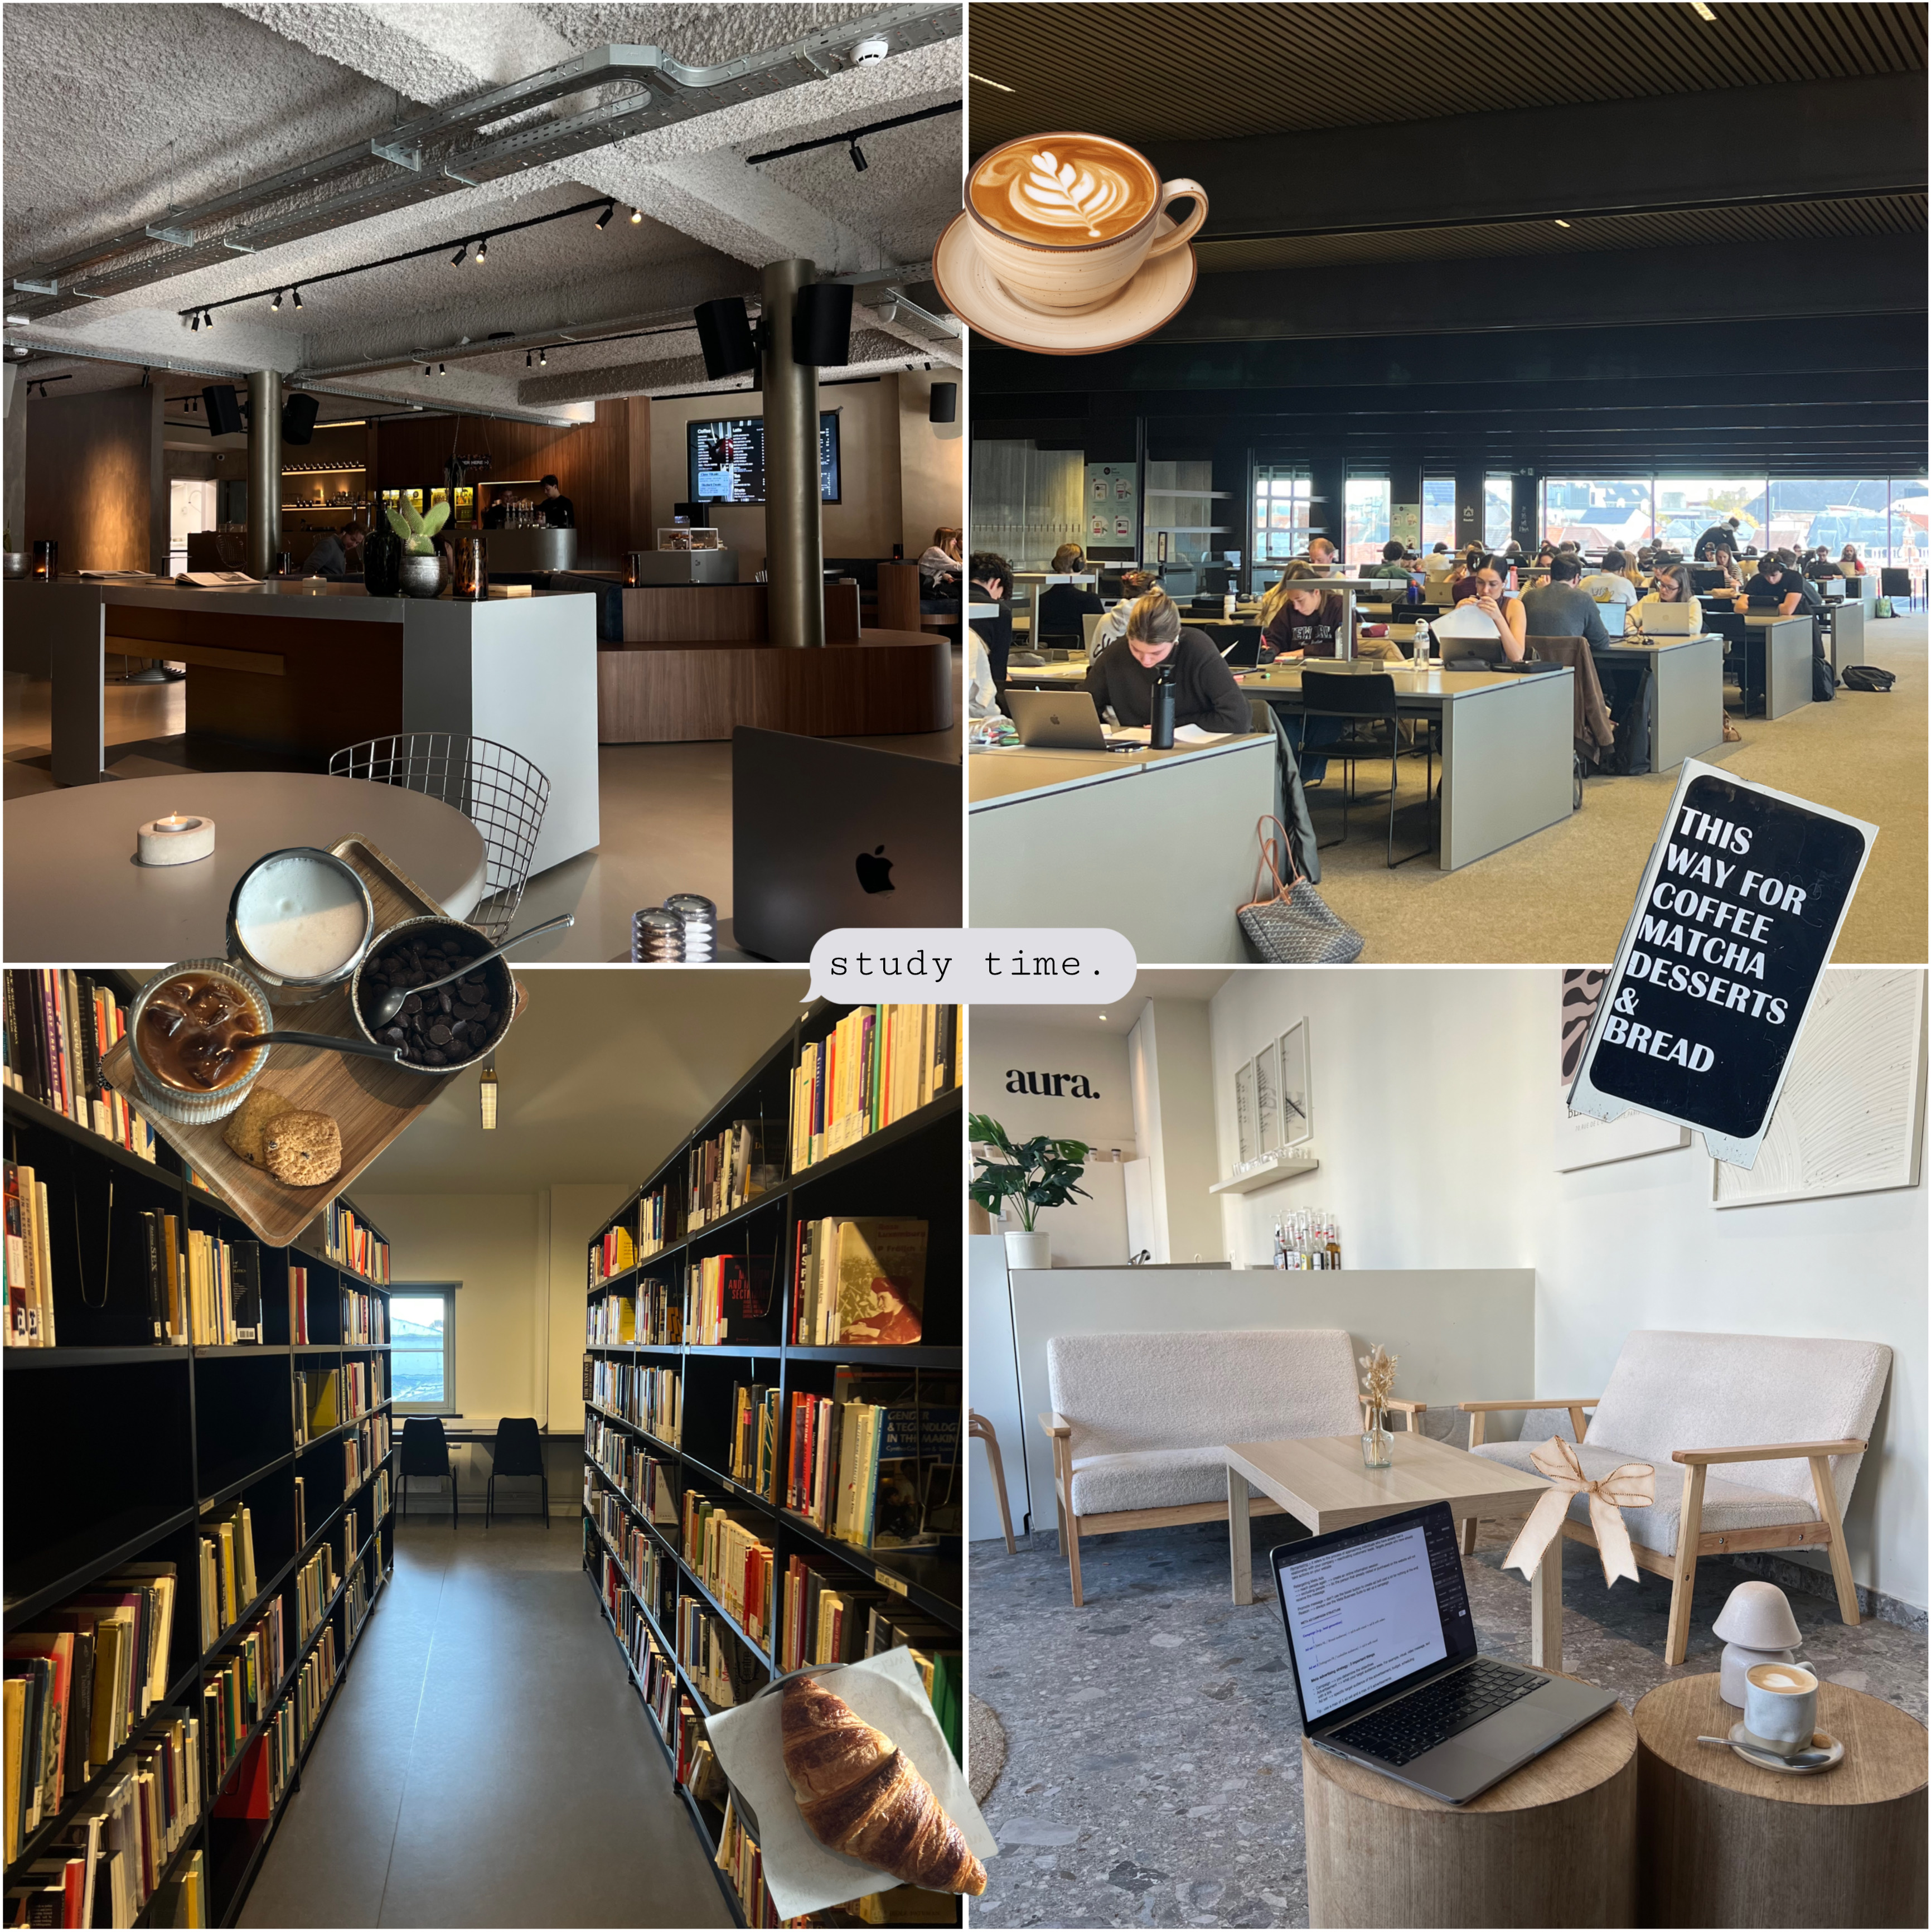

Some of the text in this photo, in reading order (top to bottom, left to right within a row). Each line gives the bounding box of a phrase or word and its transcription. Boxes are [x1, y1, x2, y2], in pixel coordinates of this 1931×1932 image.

[1681, 806, 1753, 855] THIS
[1667, 843, 1807, 915] WAY FOR
[1652, 882, 1774, 944] COFFEE
[1638, 914, 1766, 980] MATCHA
[1614, 987, 1640, 1017] &
[1625, 950, 1789, 1025] DESSERTS
[1603, 1015, 1715, 1073] BREAD
[73, 1049, 82, 1084] JUSTICE
[1005, 1069, 1101, 1099] aura.
[20, 1195, 26, 1209] ON
[728, 1279, 742, 1289] AND
[887, 1411, 930, 1421] GENDR
[887, 1422, 960, 1432] & TECNOLOG
[887, 1434, 898, 1443] IN
[922, 1434, 960, 1443] MAKIN
[722, 1656, 730, 1682] Marx
[741, 1651, 751, 1684] Centre
[1315, 1680, 1330, 1690] Campaign
[1342, 1669, 1356, 1678] determine
[1360, 1661, 1373, 1670] objectives
[1319, 1669, 1335, 1679] advertising
[1335, 1663, 1348, 1672] strategy
[1352, 1656, 1366, 1665] important
